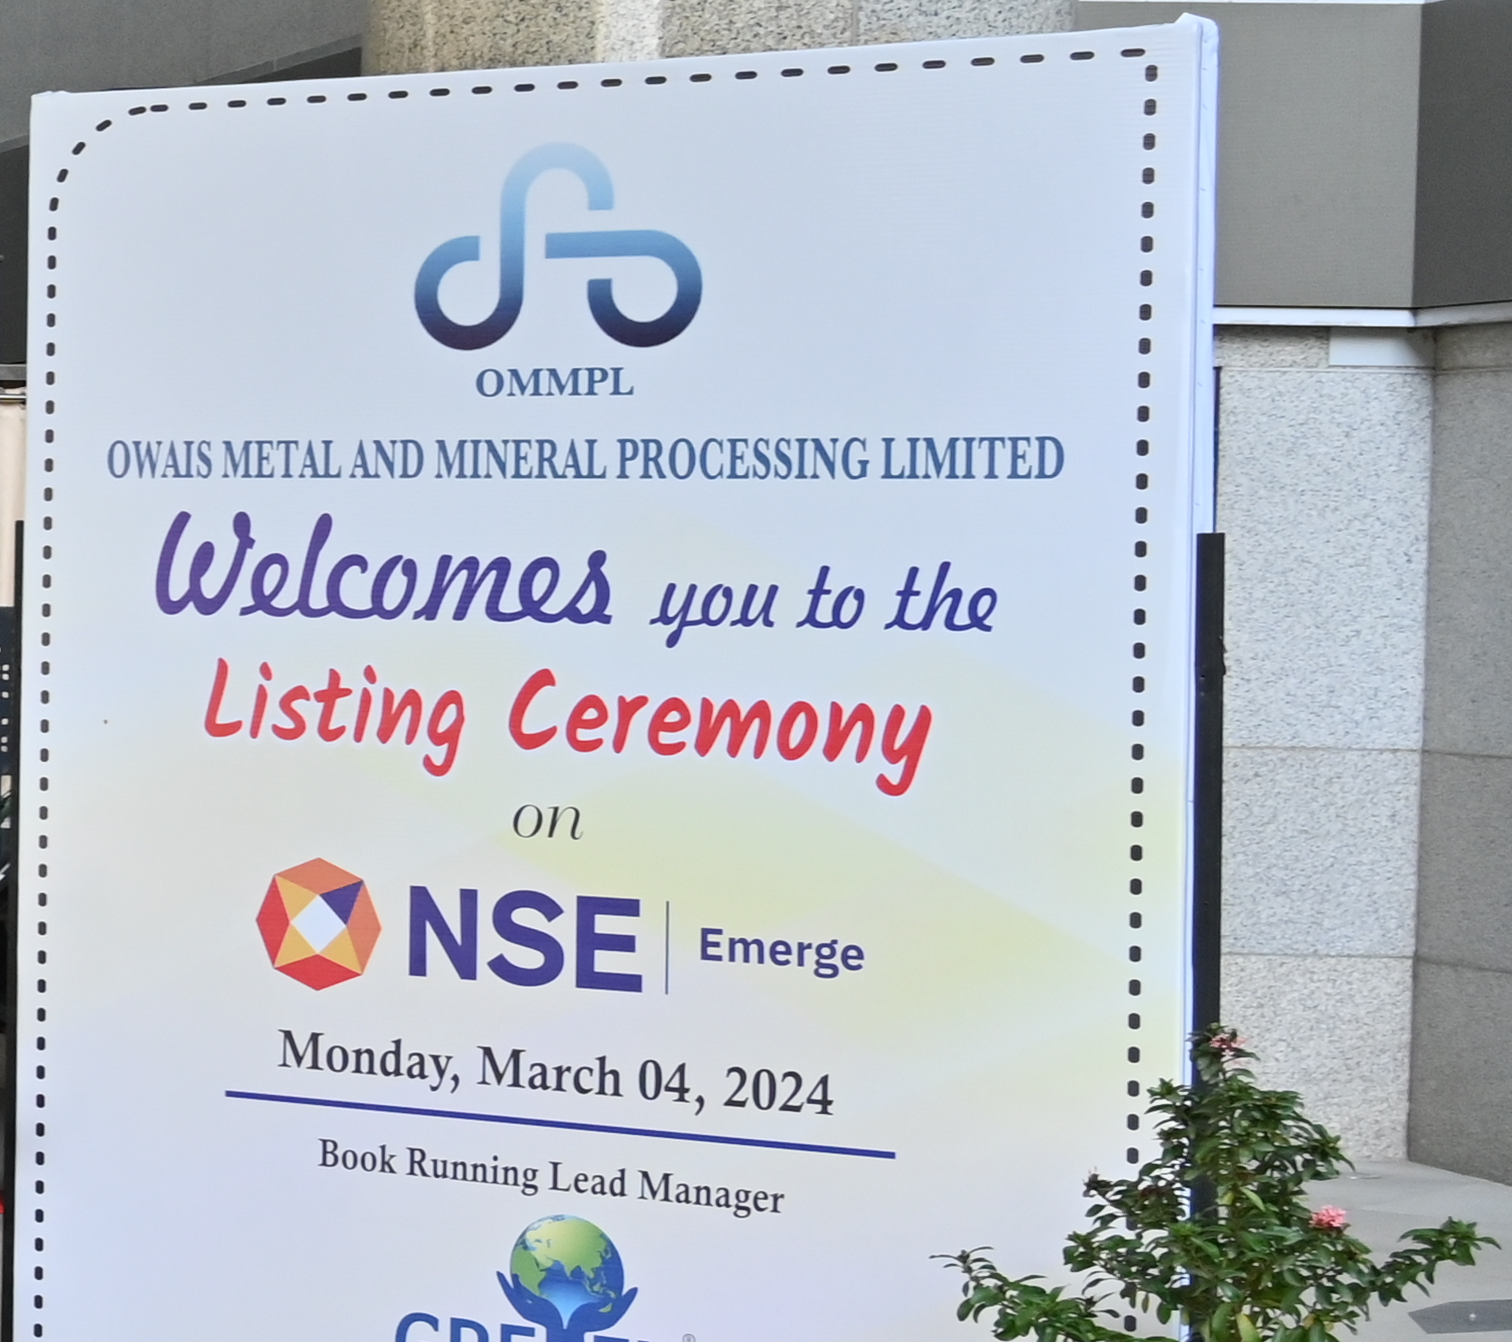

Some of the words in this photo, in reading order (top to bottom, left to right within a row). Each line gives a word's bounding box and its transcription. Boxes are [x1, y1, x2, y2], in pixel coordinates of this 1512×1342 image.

[476, 367, 634, 397] OMMPL
[108, 440, 212, 479] OWAIS
[222, 440, 341, 478] METAL
[349, 440, 424, 478] AND
[435, 439, 606, 479] MINERAL
[616, 437, 869, 480] PROCESSING
[881, 436, 1064, 479] LIMITED
[156, 511, 612, 624] Welcomes
[649, 583, 777, 648] you
[796, 565, 865, 629] to
[885, 561, 997, 632] the
[204, 658, 465, 777] Listing
[509, 668, 933, 796] Ceremony
[513, 805, 581, 840] on
[409, 885, 642, 993] NSE
[701, 928, 864, 979] Emerge
[278, 1029, 459, 1093] Monday,
[477, 1046, 623, 1097] March
[639, 1060, 705, 1116] 04,
[723, 1067, 834, 1115] 2024
[319, 1139, 397, 1174] Book
[406, 1147, 539, 1196] Running
[549, 1161, 627, 1197] Lead
[638, 1170, 785, 1218] Manager
